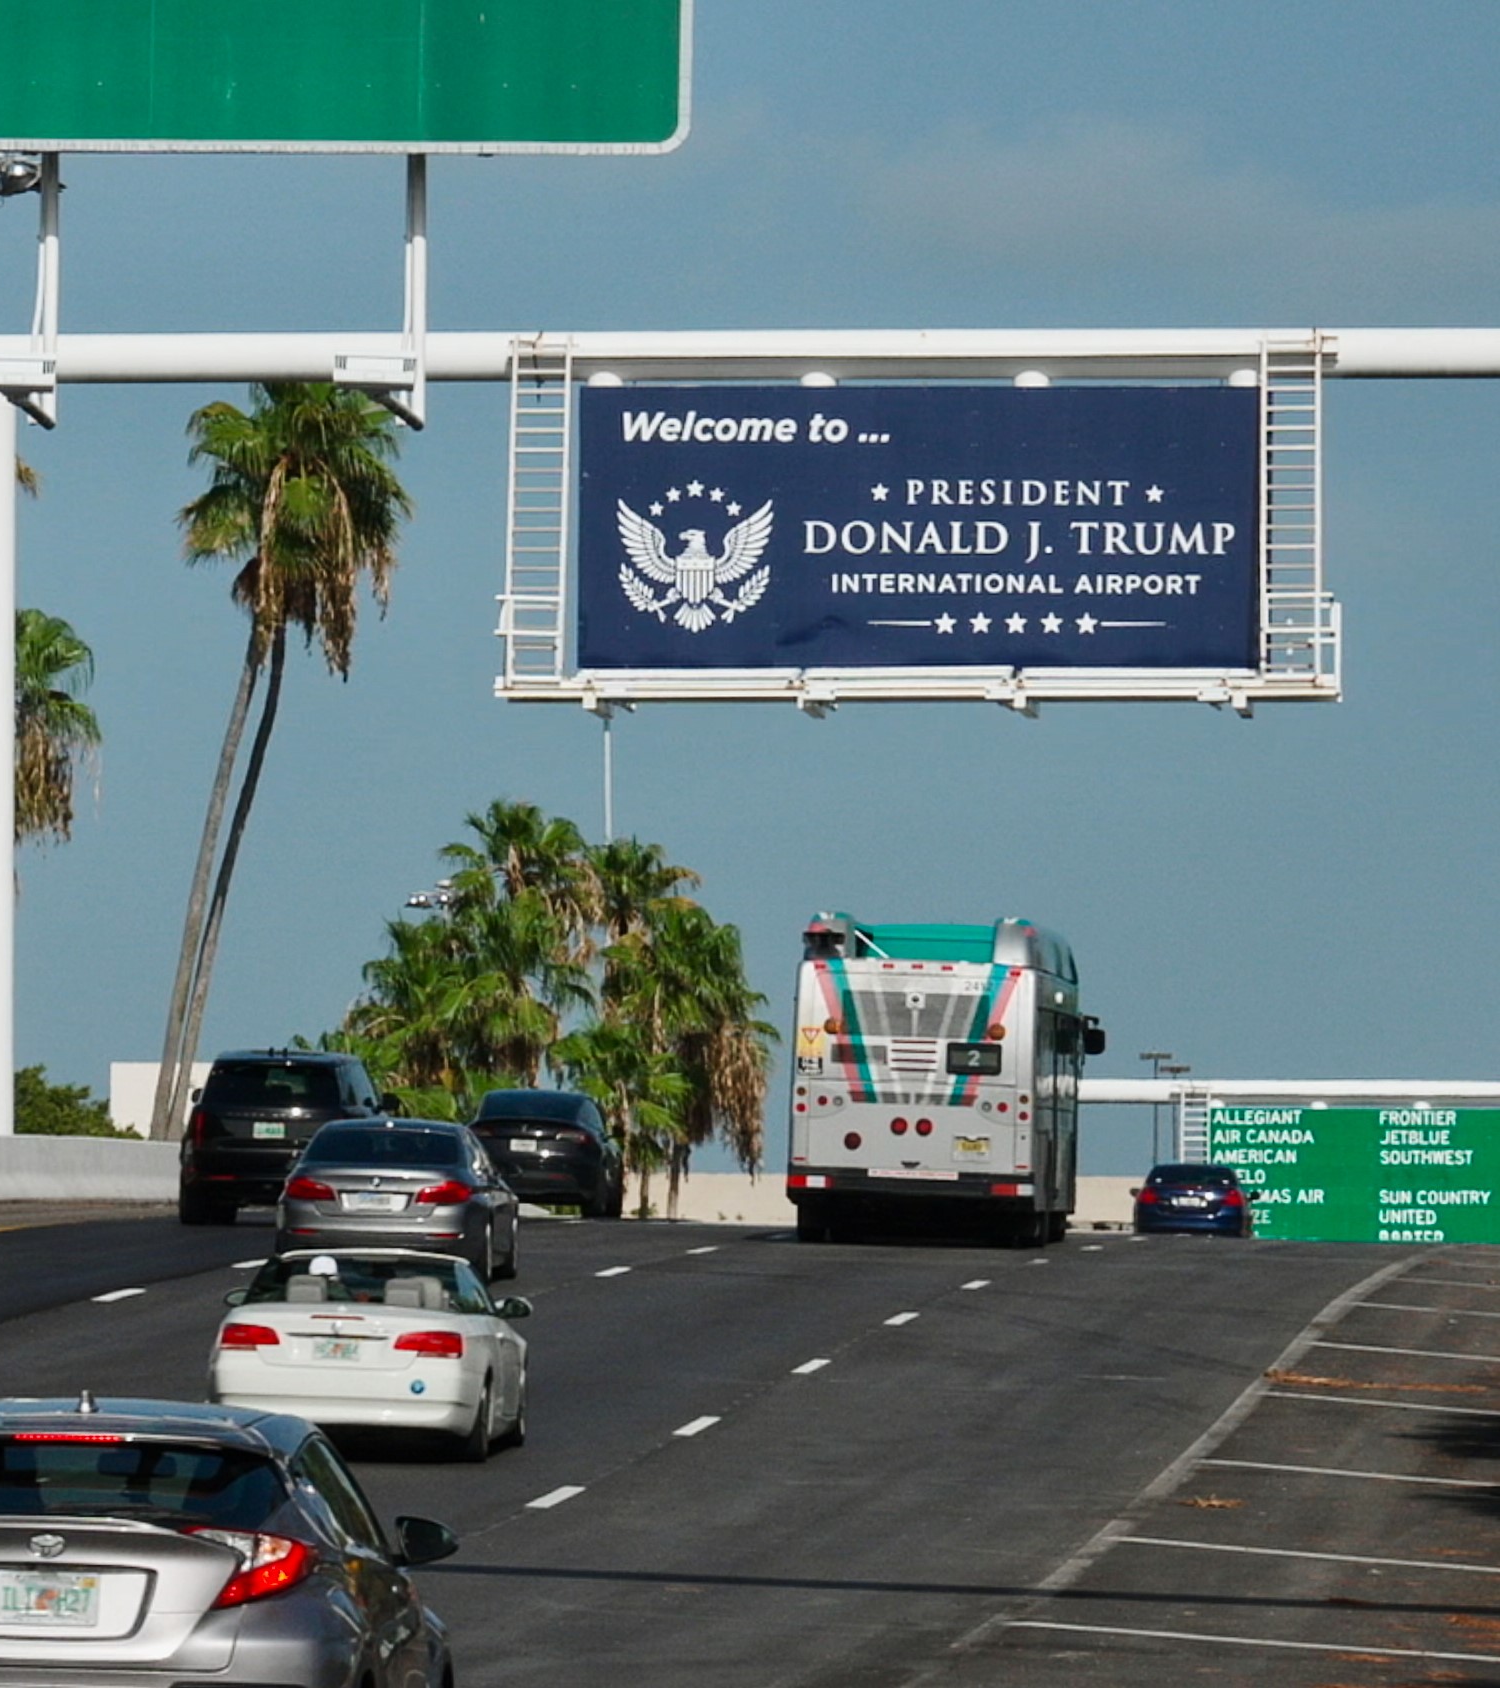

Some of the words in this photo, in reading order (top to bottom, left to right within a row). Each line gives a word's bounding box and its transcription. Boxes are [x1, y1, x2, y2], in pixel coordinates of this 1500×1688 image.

[622, 411, 797, 443] Welcome
[809, 412, 848, 443] to
[906, 479, 1130, 506] PRESIDENT
[804, 520, 1009, 554] DONALD
[1025, 521, 1053, 564] J.
[1070, 521, 1235, 555] TRUMP
[831, 573, 1064, 595] INTERNATIONAL
[1074, 574, 1201, 595] AIRPORT
[967, 1050, 980, 1067] 2
[1213, 1110, 1302, 1125] ALLEGIANT
[1379, 1110, 1457, 1126] FRONTIER
[1213, 1129, 1241, 1144] AIR
[1246, 1129, 1315, 1144] CANADA
[1380, 1130, 1450, 1145] JETBLUE
[1213, 1149, 1297, 1164] AMERICAN
[1380, 1149, 1473, 1166] SOUTHWEST
[1297, 1189, 1325, 1204] AIR
[1379, 1189, 1413, 1205] SUN
[1416, 1190, 1491, 1205] COUNTRY
[1379, 1209, 1437, 1226] UNITED
